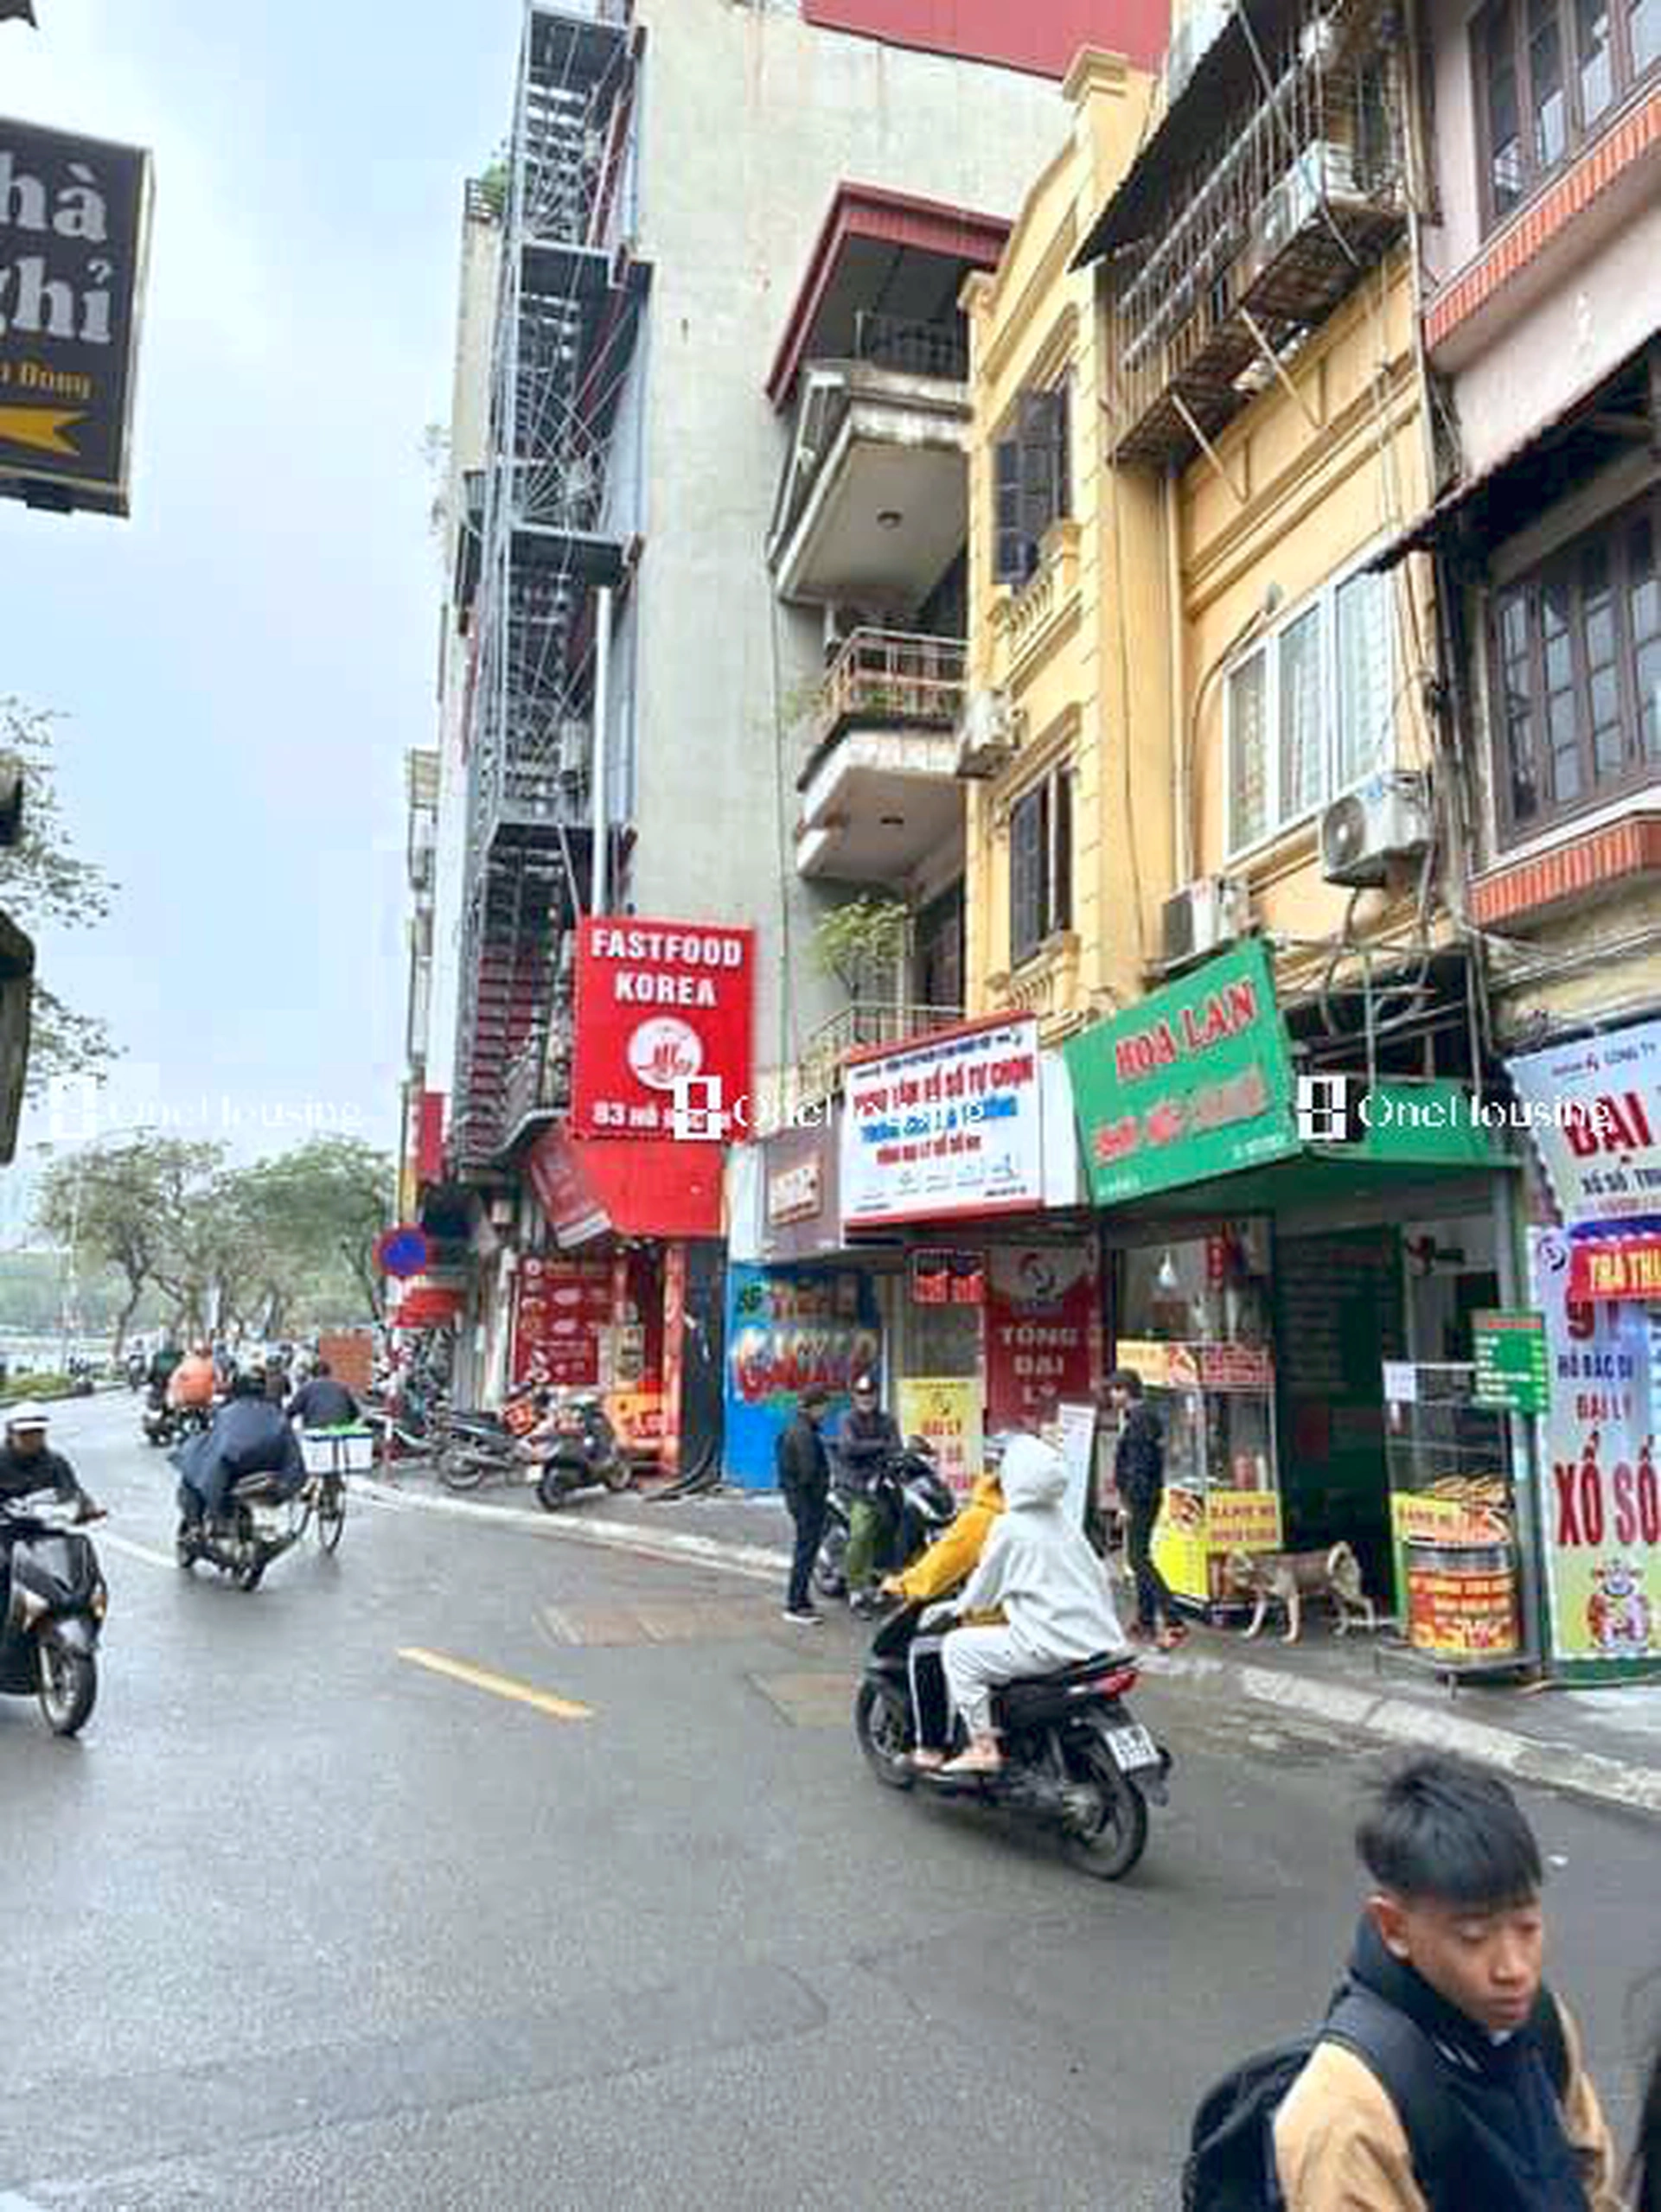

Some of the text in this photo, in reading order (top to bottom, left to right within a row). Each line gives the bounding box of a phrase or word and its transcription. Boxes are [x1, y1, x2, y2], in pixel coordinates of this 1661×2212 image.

[591, 928, 744, 966] FASTFOOD
[615, 971, 717, 1007] KOREA
[1179, 978, 1256, 1048] LAN
[591, 1101, 624, 1125] 83
[1554, 1431, 1658, 1546] XỔ SỐ
